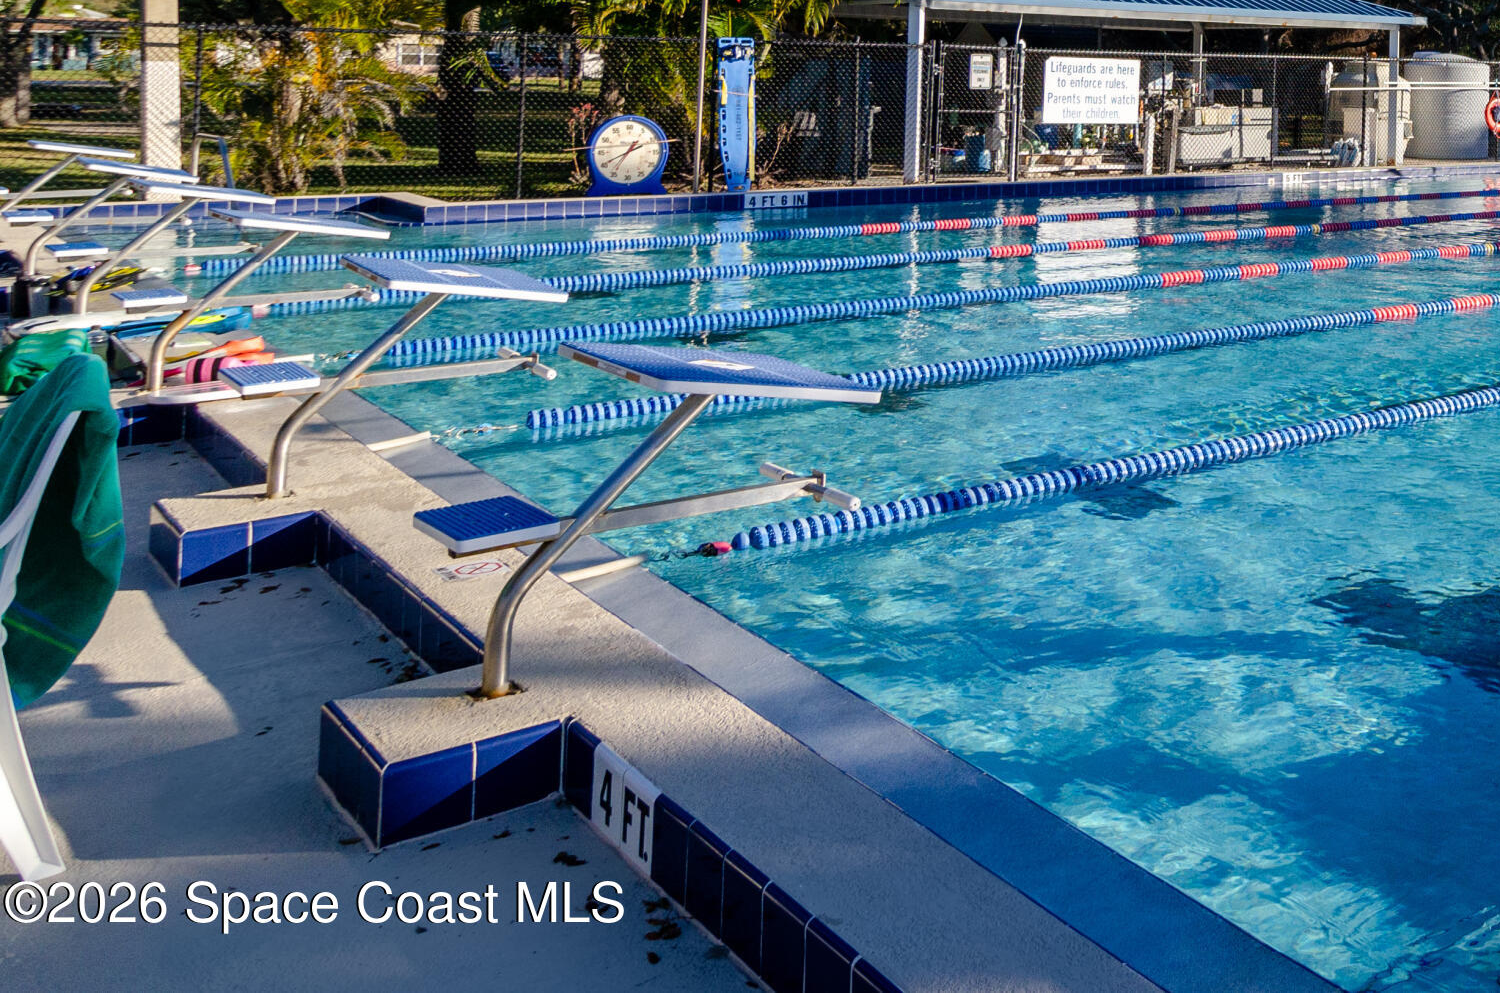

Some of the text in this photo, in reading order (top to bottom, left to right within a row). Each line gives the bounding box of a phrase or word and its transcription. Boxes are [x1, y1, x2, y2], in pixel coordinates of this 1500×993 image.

[1050, 61, 1135, 76] Lifeguards are here
[1057, 77, 1128, 89] to enforce rules.
[1047, 92, 1136, 106] Parents must watch
[1062, 108, 1120, 120] their children.
[748, 196, 756, 207] 4
[781, 194, 788, 206] 6
[599, 769, 650, 862] 4 FT.
